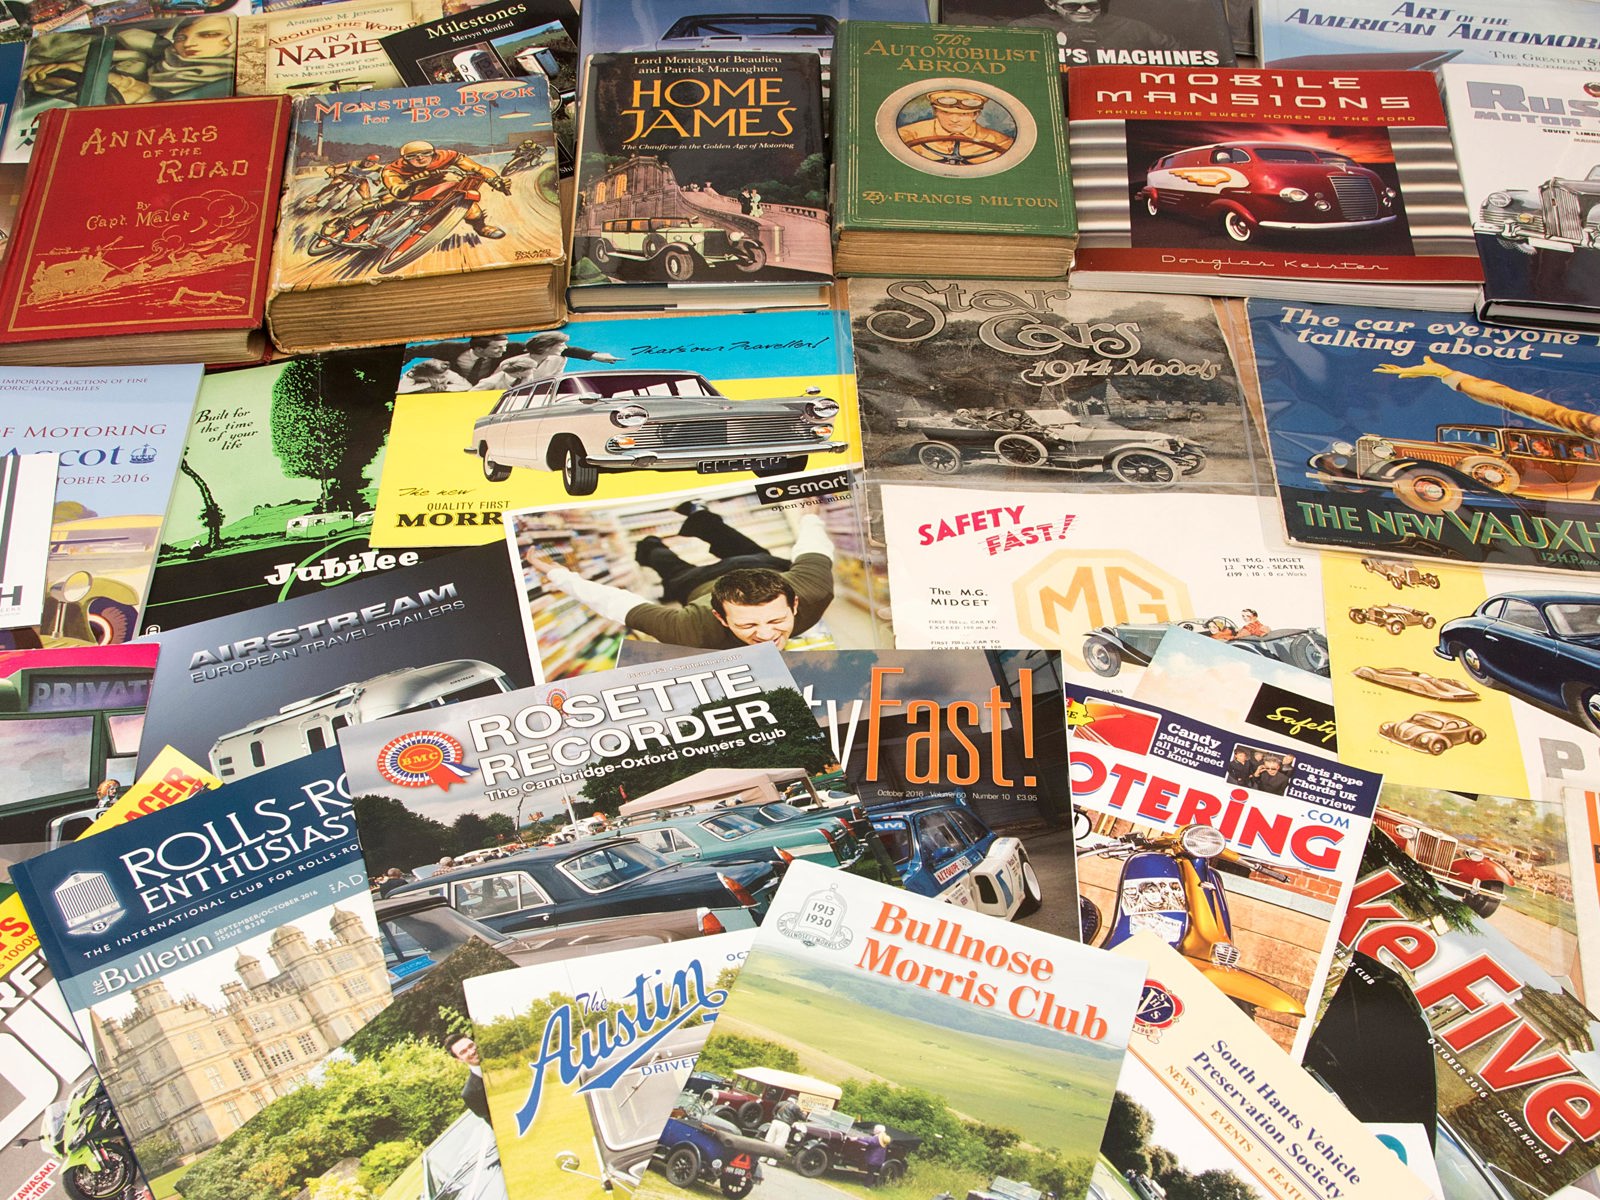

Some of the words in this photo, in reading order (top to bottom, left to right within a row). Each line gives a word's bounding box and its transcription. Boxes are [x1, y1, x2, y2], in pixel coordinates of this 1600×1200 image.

[427, 3, 527, 39] Milestones
[1285, 8, 1437, 36] AMERICAN
[1392, 2, 1455, 21] ART
[1482, 17, 1511, 25] THE
[268, 25, 332, 46] AROUND
[323, 35, 339, 43] IN
[451, 29, 482, 43] Mervyn
[483, 20, 515, 34] Benford
[933, 33, 972, 47] The
[634, 56, 662, 65] Lord
[665, 56, 716, 66] Montagu
[717, 56, 730, 64] of
[733, 55, 782, 64] Beaulieu
[864, 39, 1040, 62] AUTOMOBILIST
[1097, 49, 1219, 66] MACHINES
[638, 66, 661, 74] and
[664, 65, 706, 74] Patrick
[708, 65, 778, 75] Macnaghten
[897, 58, 1007, 75] ABROAD
[632, 78, 790, 108] HOME
[1140, 72, 1360, 90] MOBILE
[314, 95, 440, 124] MONSTER
[460, 86, 536, 105] BOOK
[1097, 90, 1410, 110] MANSIONS
[362, 114, 390, 125] for
[411, 104, 488, 123] BOYS
[620, 107, 797, 144] JAMES
[1474, 111, 1582, 127] MOTOR
[80, 125, 218, 155] ANNALS
[733, 143, 748, 151] Age
[749, 142, 757, 150] of
[758, 142, 795, 150] Motoring
[143, 149, 161, 158] OF
[169, 148, 202, 156] THE
[156, 159, 249, 184] ROAD
[136, 201, 152, 212] By
[981, 195, 1058, 208] MILTOUN
[1161, 254, 1275, 270] Douglas
[1284, 259, 1389, 271] Keister
[866, 281, 1071, 343] Star
[978, 311, 1141, 359] Cars
[1280, 306, 1340, 327] The
[1354, 318, 1415, 334] car
[1427, 321, 1580, 346] everyone
[1296, 327, 1415, 357] talking
[2, 378, 60, 386] IMPORTANT
[1021, 359, 1113, 387] 1914
[1113, 358, 1221, 381] Models
[195, 408, 230, 424] Built
[231, 406, 251, 422] for
[200, 420, 220, 433] the
[224, 419, 254, 431] time
[24, 424, 167, 438] MOTORING
[208, 432, 224, 443] of
[229, 429, 259, 444] your
[220, 438, 243, 451] life
[788, 475, 849, 495] smart
[427, 501, 474, 511] QUALITY
[480, 501, 510, 510] FIRST
[771, 502, 798, 512] open
[799, 498, 823, 509] your
[826, 493, 852, 503] mind
[918, 505, 1025, 547] SAFETY
[1296, 501, 1364, 532] THE
[1367, 509, 1443, 541] NEW
[985, 515, 1076, 556] FAST!
[263, 549, 420, 587] Jubilee
[929, 587, 951, 595] The
[960, 589, 988, 597] M.G.
[930, 598, 989, 606] MIDGET
[1038, 566, 1169, 634] MG
[187, 582, 460, 671] AIRSTREAM
[191, 649, 301, 685] EUROPEAN
[302, 628, 374, 655] TRAVEL
[376, 599, 467, 633] TRAILERS
[467, 664, 761, 752] ROSETTE
[866, 667, 1038, 787] Fast!
[1266, 706, 1337, 739] Safety
[478, 699, 778, 787] RECORDER
[1158, 732, 1191, 748] paint
[1191, 740, 1222, 758] jobs:
[1167, 723, 1222, 749] Candy
[399, 750, 440, 767] BMC
[485, 784, 518, 802] The
[522, 749, 678, 794] Cambridge-Oxford
[681, 738, 745, 764] Owners
[748, 727, 787, 745] Club
[1153, 747, 1165, 755] to
[1166, 750, 1200, 767] know
[1156, 741, 1170, 750] all
[1173, 745, 1195, 759] you
[1197, 752, 1224, 768] need
[1297, 762, 1330, 778] Chris
[1333, 769, 1364, 787] Pope
[1307, 774, 1317, 783] &
[1319, 779, 1343, 790] The
[878, 789, 905, 797] October
[973, 792, 999, 800] Number
[1017, 794, 1038, 802] £3.95
[1288, 787, 1356, 814] interview
[1292, 777, 1337, 796] Chords
[1339, 789, 1358, 803] UK
[1301, 807, 1350, 830] .COM
[84, 944, 111, 959] THE
[116, 898, 226, 947] INTERNATIONAL
[230, 881, 264, 900] CLUB
[268, 869, 295, 884] FOR
[214, 897, 300, 937] SEPTEMBER/OCTOBER
[301, 889, 319, 900] 2016
[805, 913, 833, 928] 1930
[812, 902, 836, 916] 1913
[217, 928, 243, 943] ISSUE
[870, 901, 1054, 982] Bullnose
[102, 932, 215, 993] Bulletin
[1355, 967, 1376, 985] CLUB
[855, 938, 997, 1008] Morris
[1008, 984, 1108, 1041] Club
[574, 991, 609, 1014] The
[515, 959, 729, 1137] Austin
[1165, 1064, 1198, 1097] NEWS
[1210, 1109, 1254, 1153] EVENTS
[1211, 1038, 1256, 1085] South
[1256, 1082, 1304, 1131] Hants
[1306, 1127, 1362, 1186] Vehicle
[1427, 1037, 1467, 1077] OCTOBER
[1464, 1075, 1489, 1099] 2016
[1496, 1108, 1524, 1135] ISSUE
[1519, 1131, 1553, 1166] NO:185
[1192, 1050, 1287, 1146] Preservation
[1286, 1142, 1345, 1200] Society
